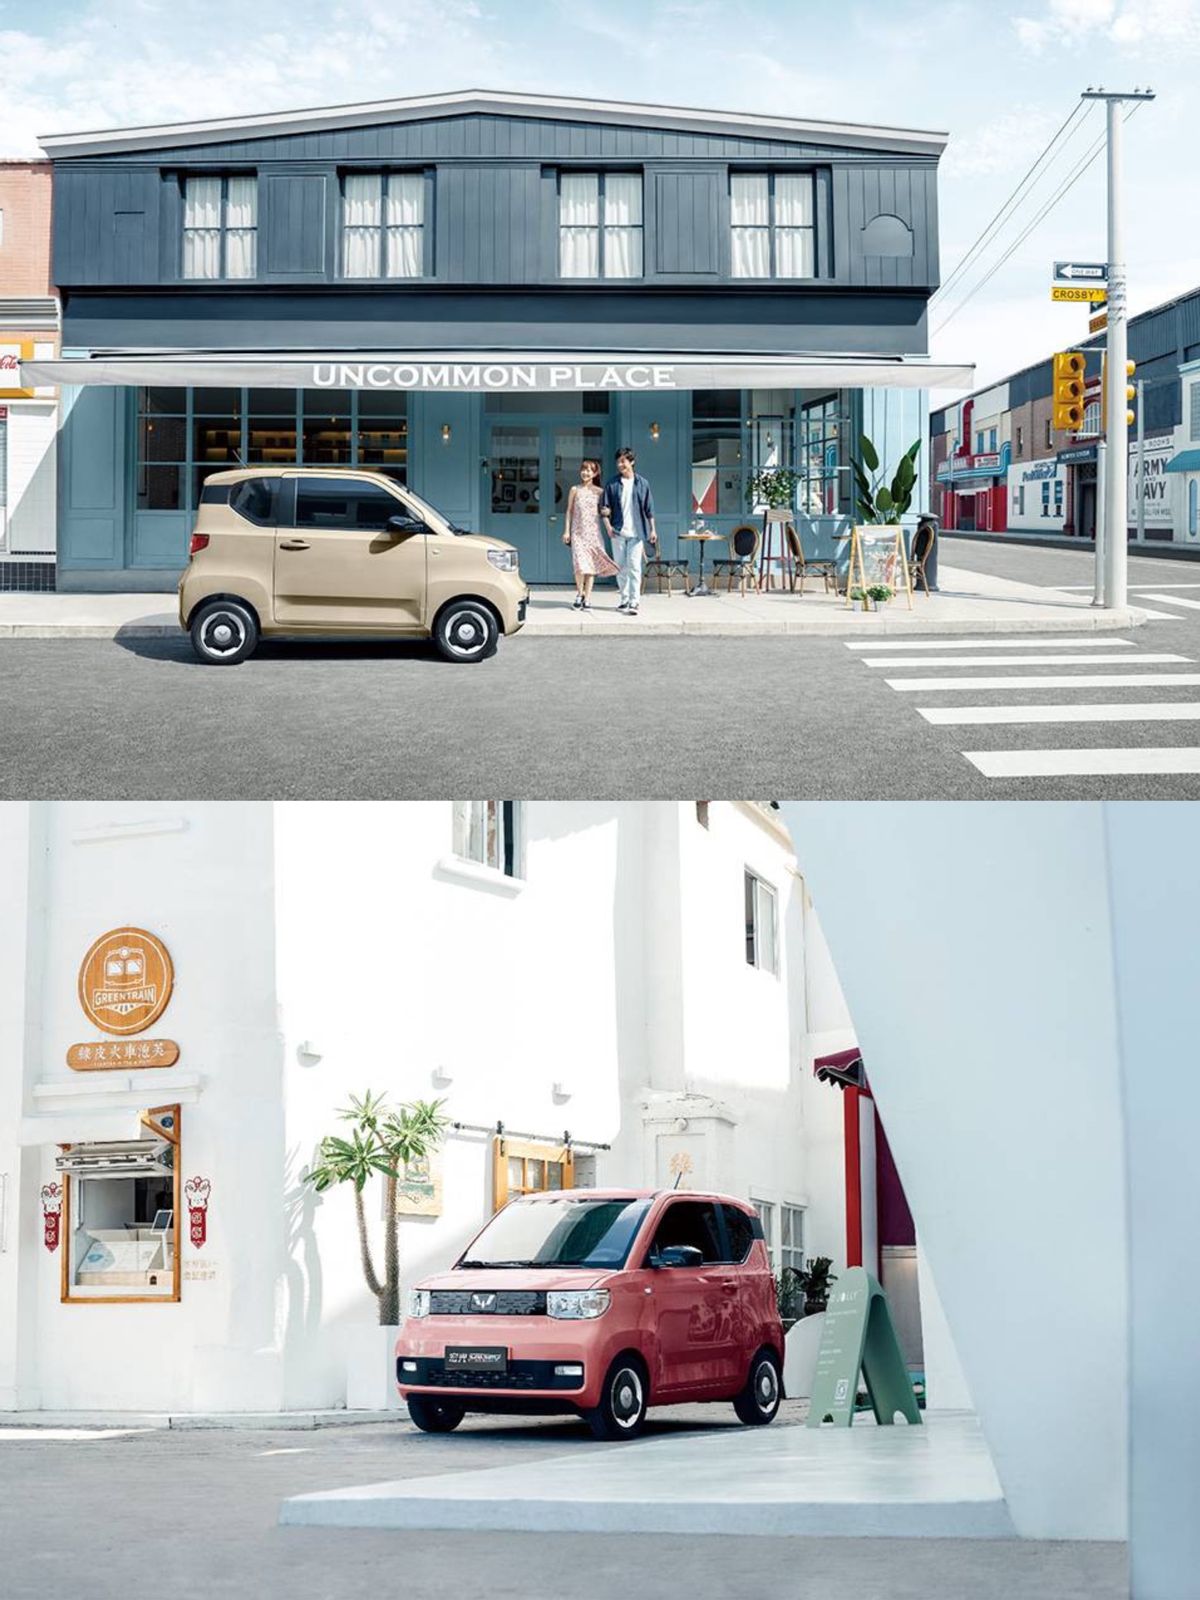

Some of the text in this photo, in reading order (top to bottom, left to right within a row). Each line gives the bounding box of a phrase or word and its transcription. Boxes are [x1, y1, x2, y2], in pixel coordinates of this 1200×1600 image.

[1053, 290, 1095, 299] CROSBY
[312, 364, 676, 388] UNCOMMON PLACE
